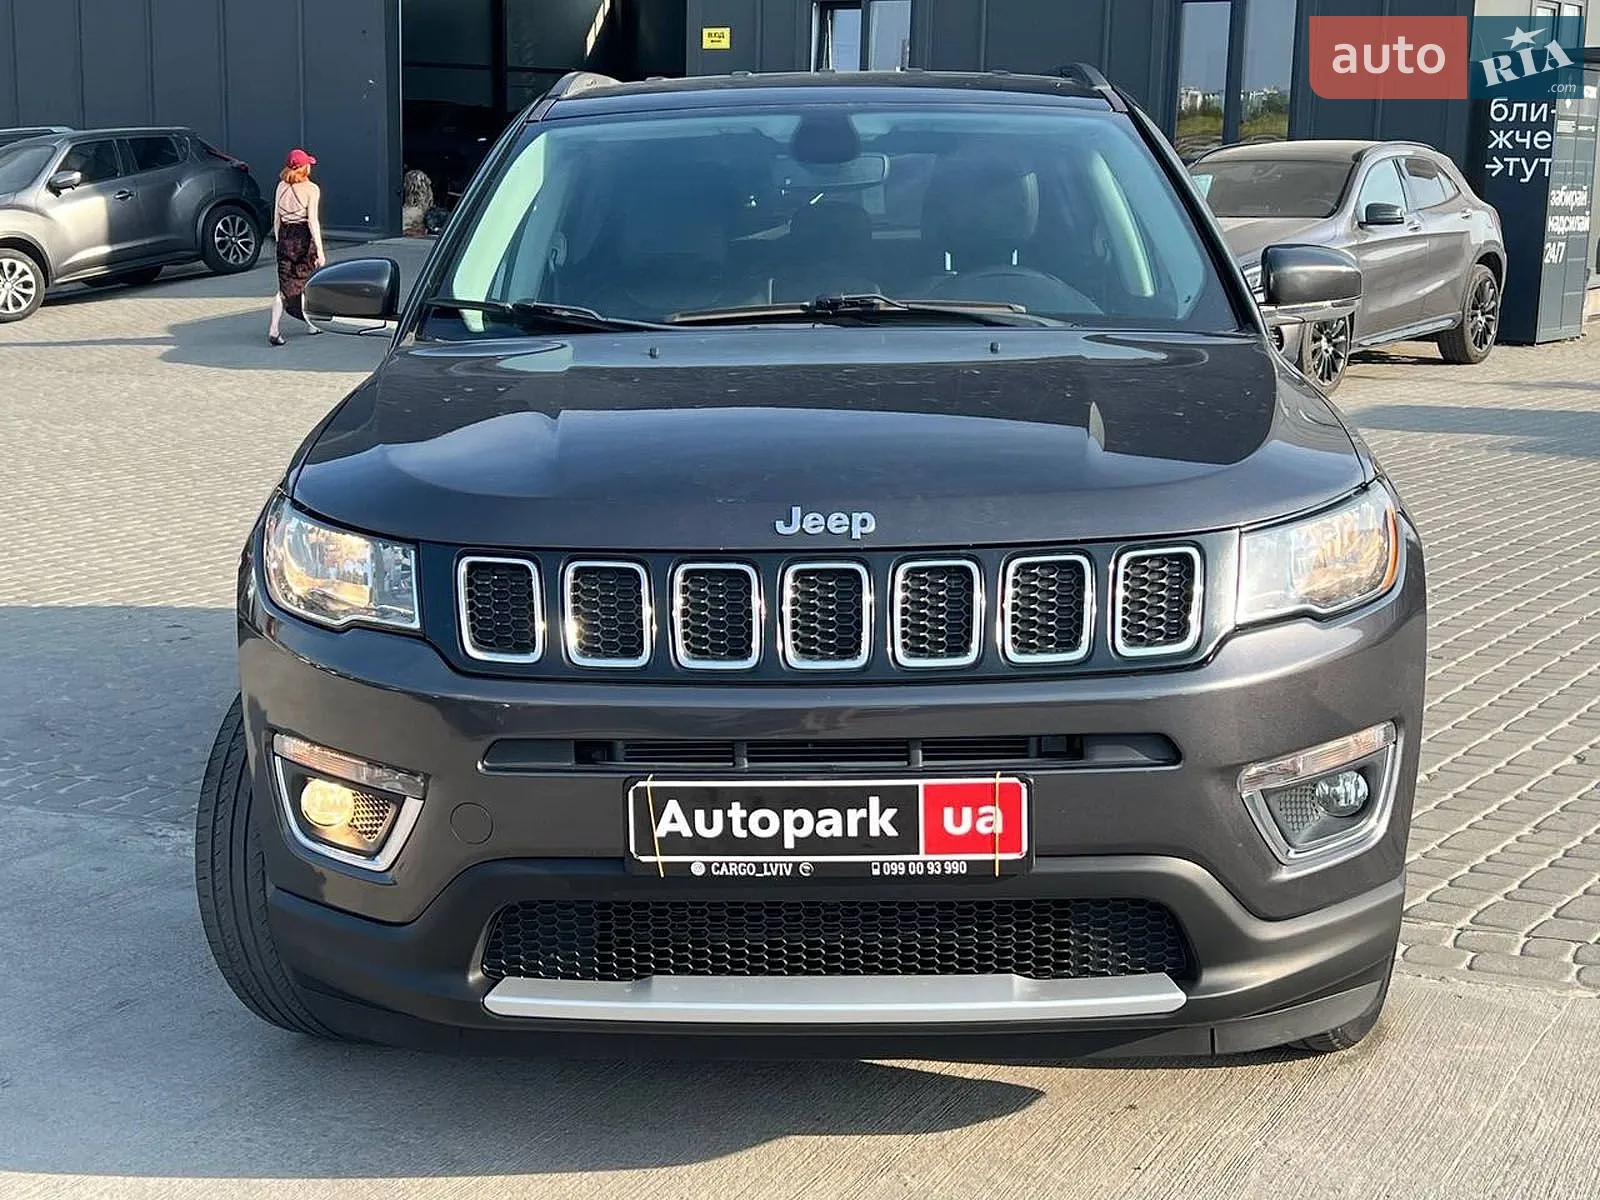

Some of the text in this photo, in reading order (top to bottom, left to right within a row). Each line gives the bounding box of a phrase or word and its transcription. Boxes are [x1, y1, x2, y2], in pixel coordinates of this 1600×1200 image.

[1487, 130, 1553, 150] жче
[1503, 157, 1553, 183] тут
[1550, 185, 1588, 212] забирай
[1547, 210, 1591, 235] надсилай
[1543, 240, 1567, 264] 24/7
[775, 506, 877, 540] Jeep
[655, 796, 1004, 849] Autopark ua
[710, 862, 793, 877] CARGO_LVIV
[882, 860, 968, 876] 099 00 93 990
